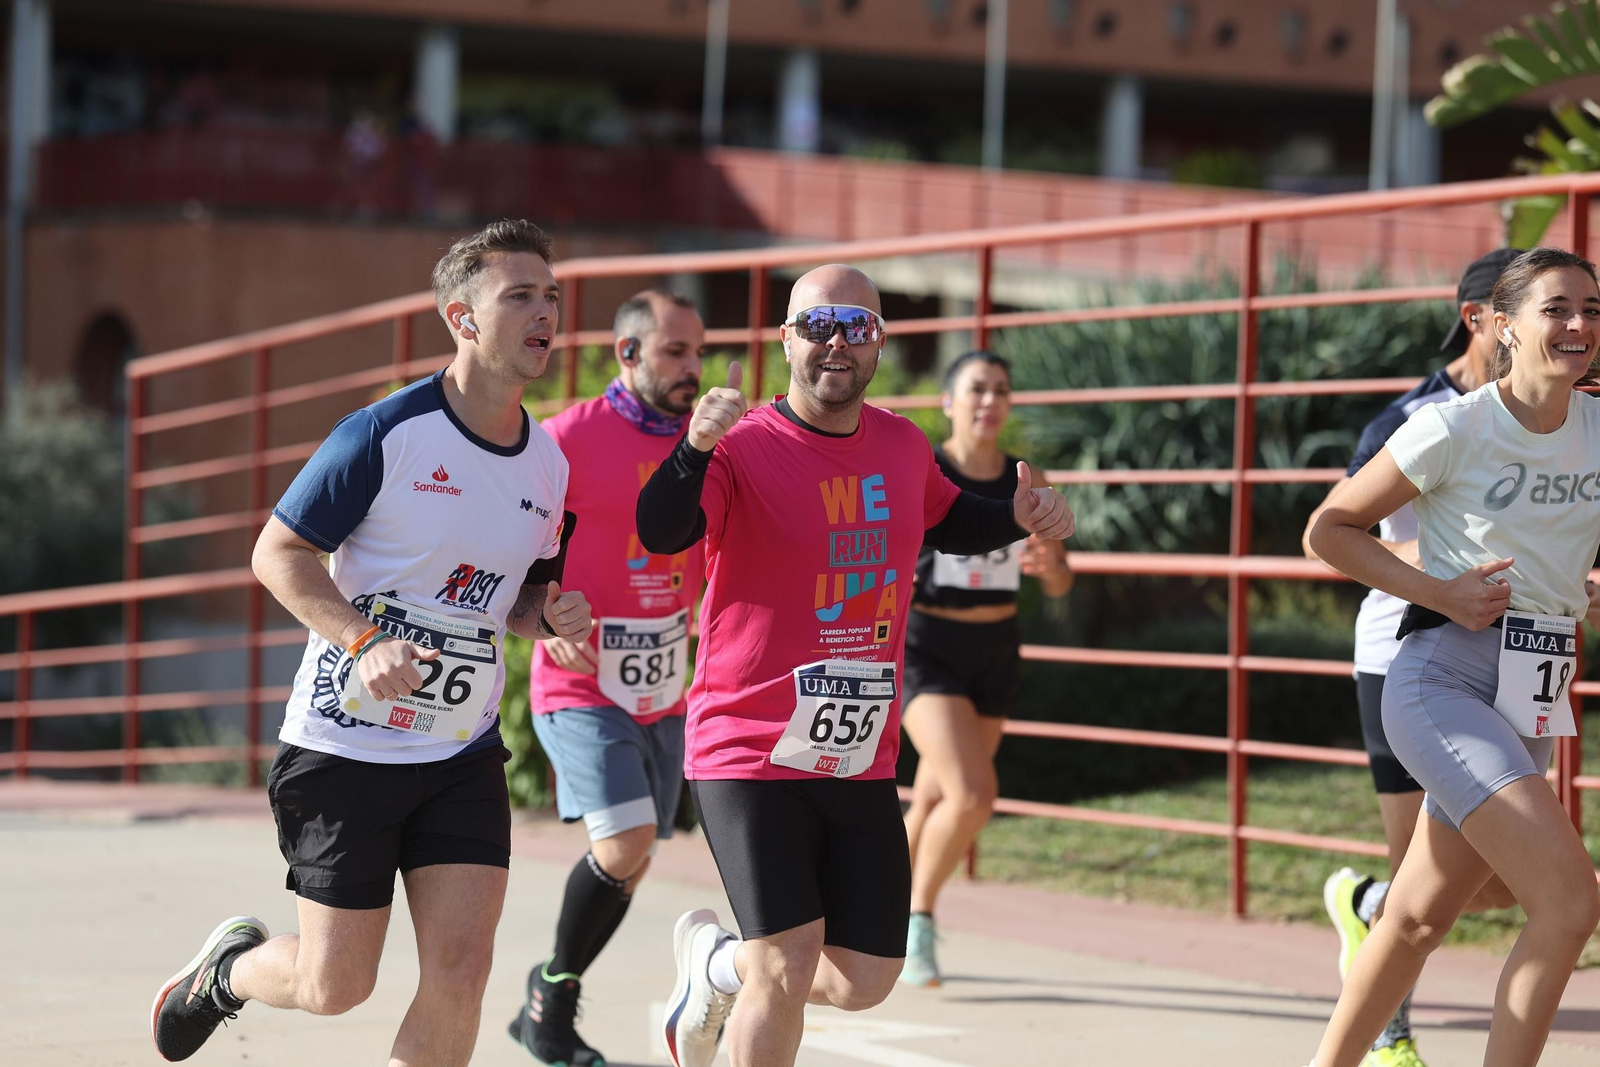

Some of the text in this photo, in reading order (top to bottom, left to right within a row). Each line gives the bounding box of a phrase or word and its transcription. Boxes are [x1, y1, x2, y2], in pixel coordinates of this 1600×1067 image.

[413, 481, 462, 497] Santander
[818, 473, 890, 525] WE
[834, 531, 884, 563] RUN
[814, 568, 897, 622] UMA
[440, 599, 488, 615] SOLIDARIA
[408, 617, 446, 632] UNIVERSIDAD
[409, 612, 432, 623] CARRERA
[433, 619, 454, 628] POPULAR
[376, 617, 435, 649] UMA
[605, 635, 655, 648] UMA
[1509, 631, 1560, 652] UMA
[620, 646, 676, 686] 681
[410, 657, 476, 706] 26
[802, 678, 853, 696] UMA
[417, 701, 437, 710] FERRER
[391, 711, 414, 725] WE
[417, 712, 436, 721] RUN
[809, 702, 881, 746] 656
[412, 723, 432, 733] RUN
[818, 759, 839, 770] WE
